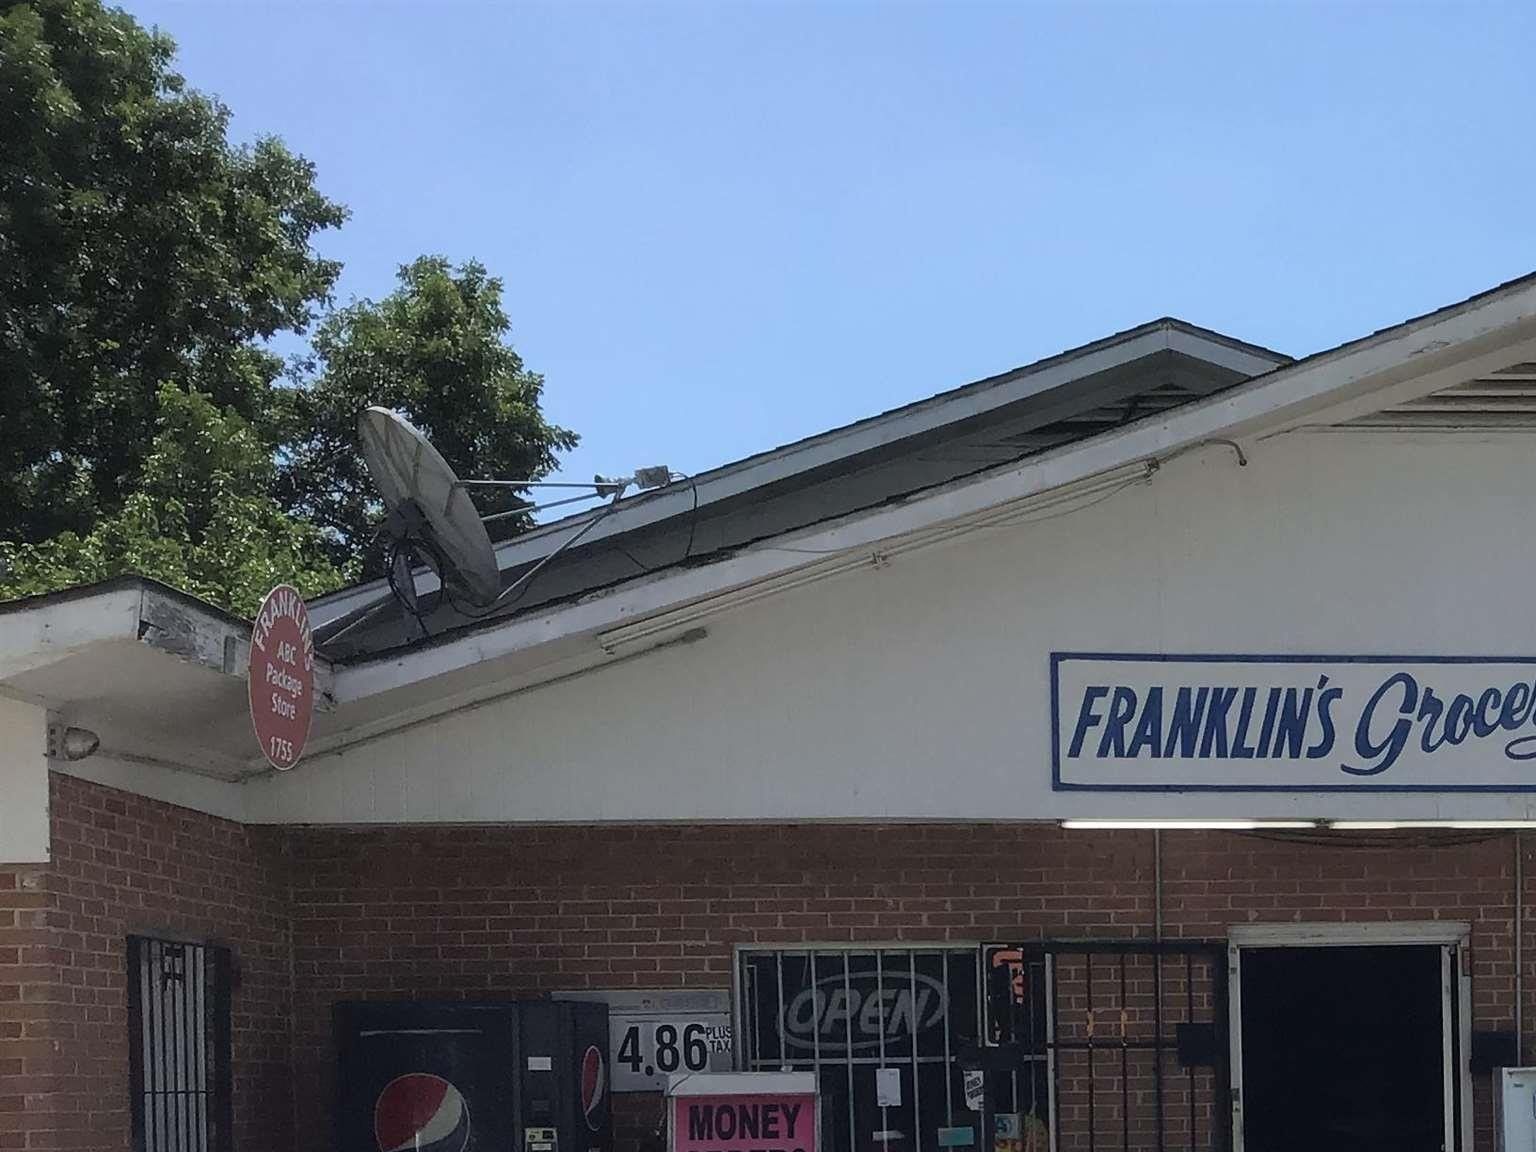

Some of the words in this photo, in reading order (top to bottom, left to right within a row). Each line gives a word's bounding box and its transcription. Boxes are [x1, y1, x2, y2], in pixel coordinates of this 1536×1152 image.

[277, 640, 297, 667] ABC
[265, 662, 303, 699] Package
[271, 692, 296, 721] Store
[1066, 673, 1344, 760] FRANKLIN'S
[270, 735, 293, 762] 1755
[786, 987, 929, 1035] OPEN
[617, 1022, 709, 1077] 4.86
[705, 1026, 733, 1040] PLUS
[709, 1039, 731, 1053] TAX
[688, 1103, 802, 1142] MONEY
